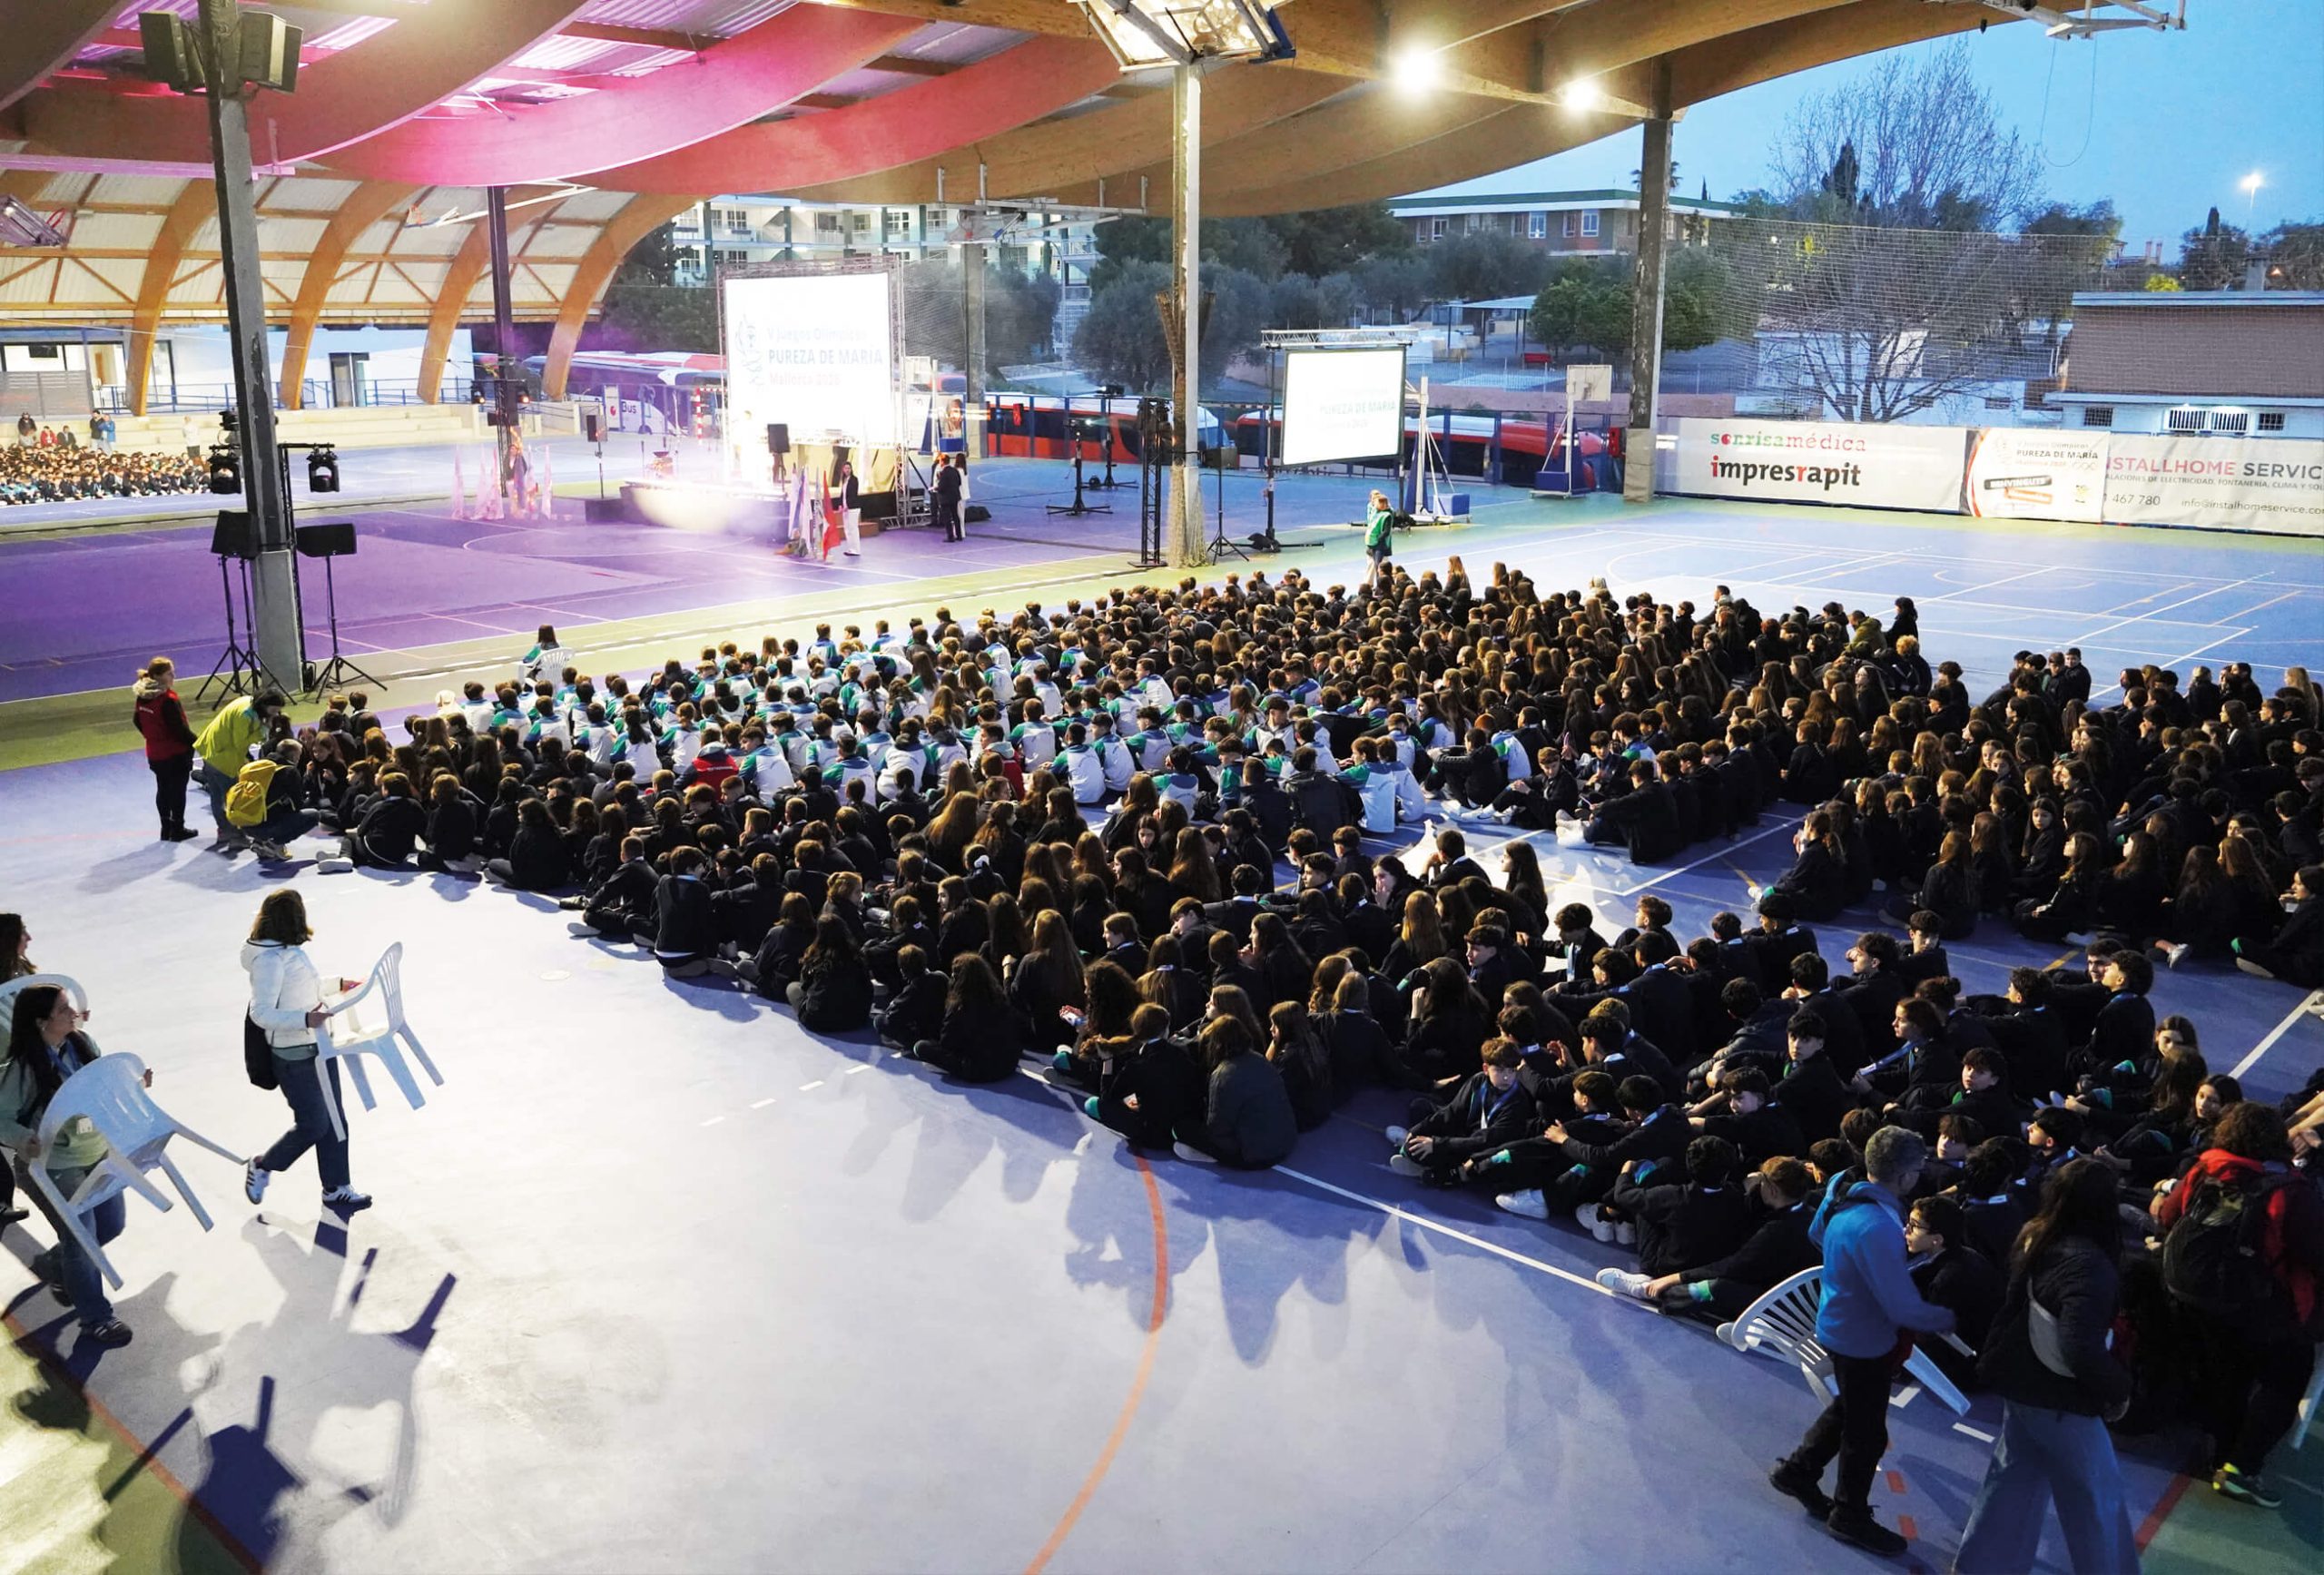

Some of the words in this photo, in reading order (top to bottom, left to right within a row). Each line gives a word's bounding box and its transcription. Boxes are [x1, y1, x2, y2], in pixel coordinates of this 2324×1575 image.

[768, 349, 816, 364] PUREZA
[820, 349, 834, 364] DE
[1710, 431, 1866, 451] sonrisamédica
[2016, 449, 2051, 458] PUREZA
[2053, 450, 2064, 458] DE
[1710, 455, 1861, 490] impresrapit
[2242, 462, 2323, 479] SERVIC
[2112, 494, 2134, 504] 467
[2139, 495, 2161, 506] 780
